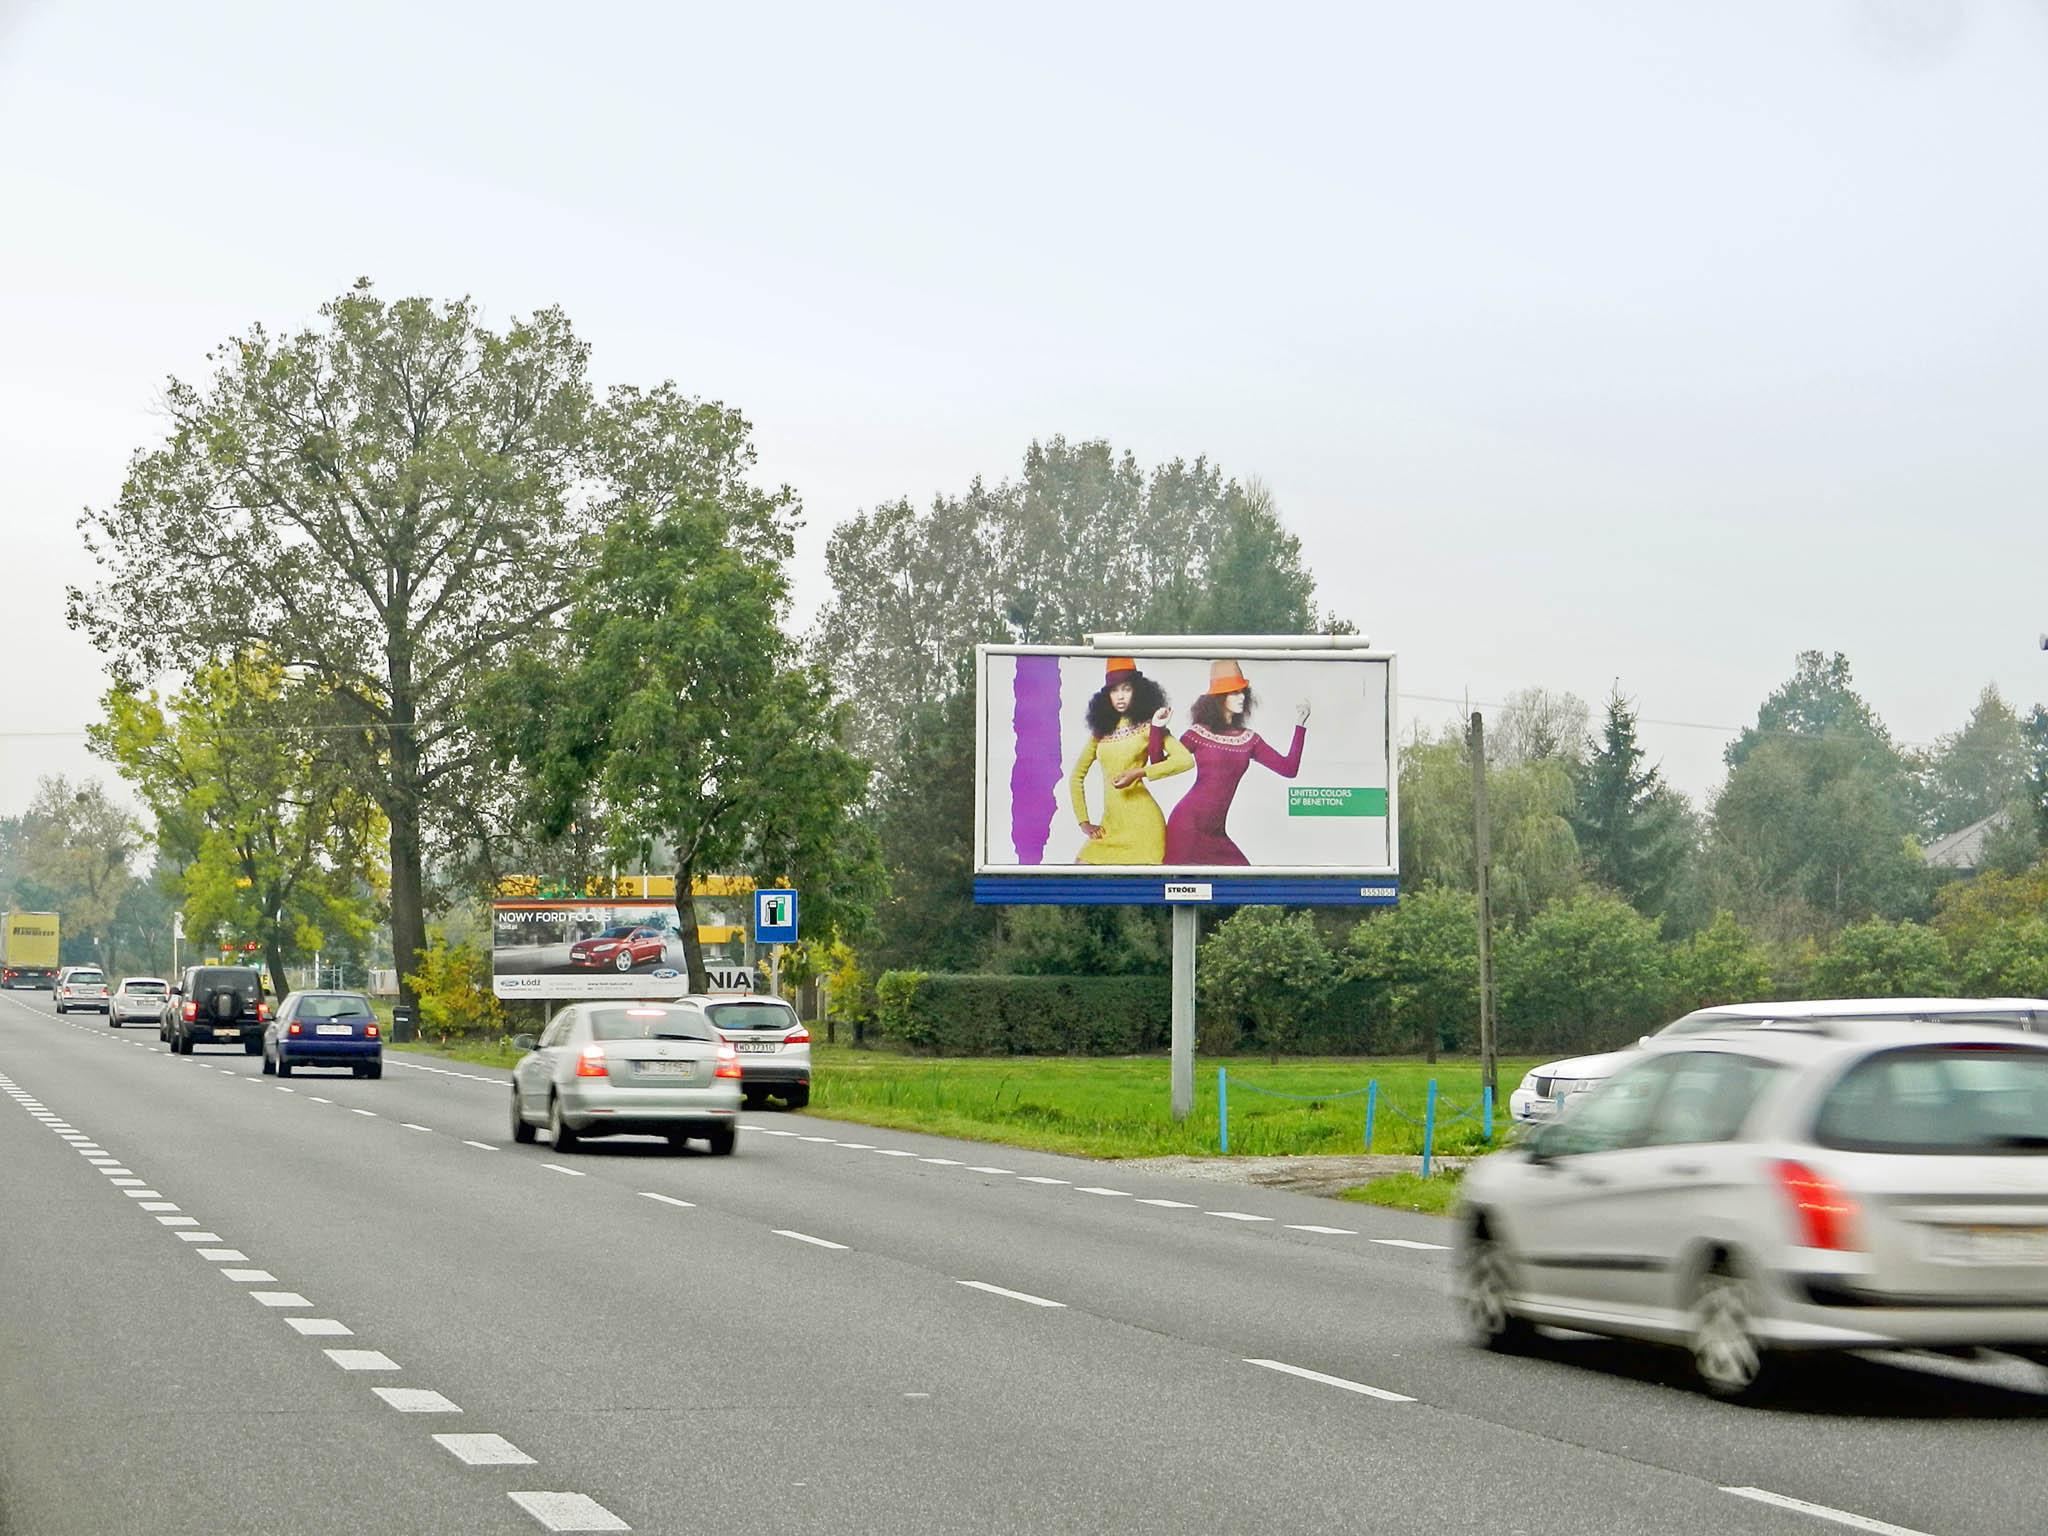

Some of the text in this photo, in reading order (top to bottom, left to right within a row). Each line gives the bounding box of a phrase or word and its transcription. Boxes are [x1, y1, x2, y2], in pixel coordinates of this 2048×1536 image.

[1290, 789, 1352, 797] UNITED COLORS
[1290, 798, 1301, 806] OF
[499, 911, 612, 922] NOWY FORD FOCUS
